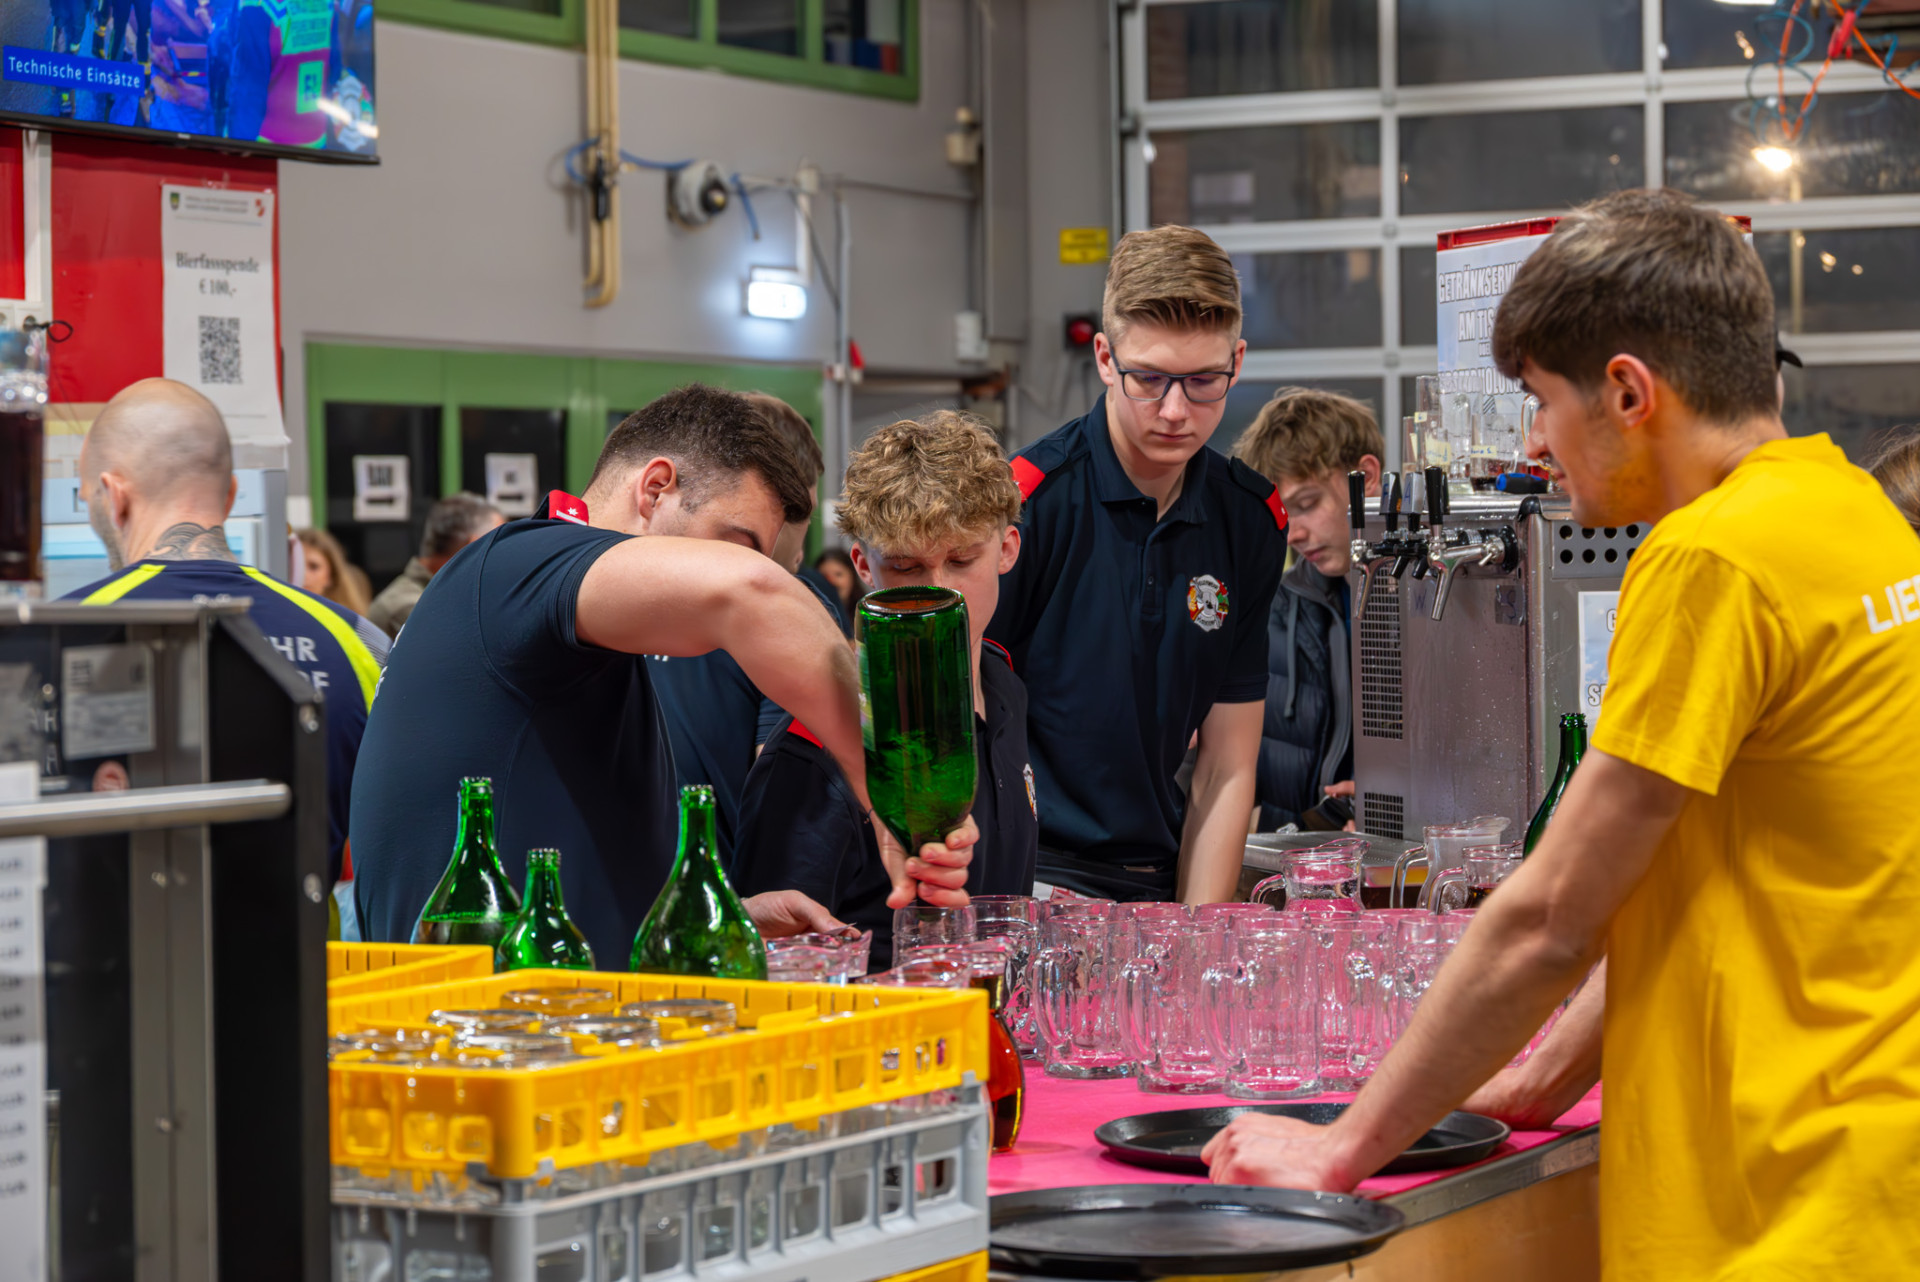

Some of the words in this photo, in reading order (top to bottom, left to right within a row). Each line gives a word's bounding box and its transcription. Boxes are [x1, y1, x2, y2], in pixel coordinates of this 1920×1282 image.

[8, 56, 82, 80] Technische
[87, 67, 141, 88] Einsätze
[1458, 310, 1476, 342] AM
[263, 636, 319, 663] HR
